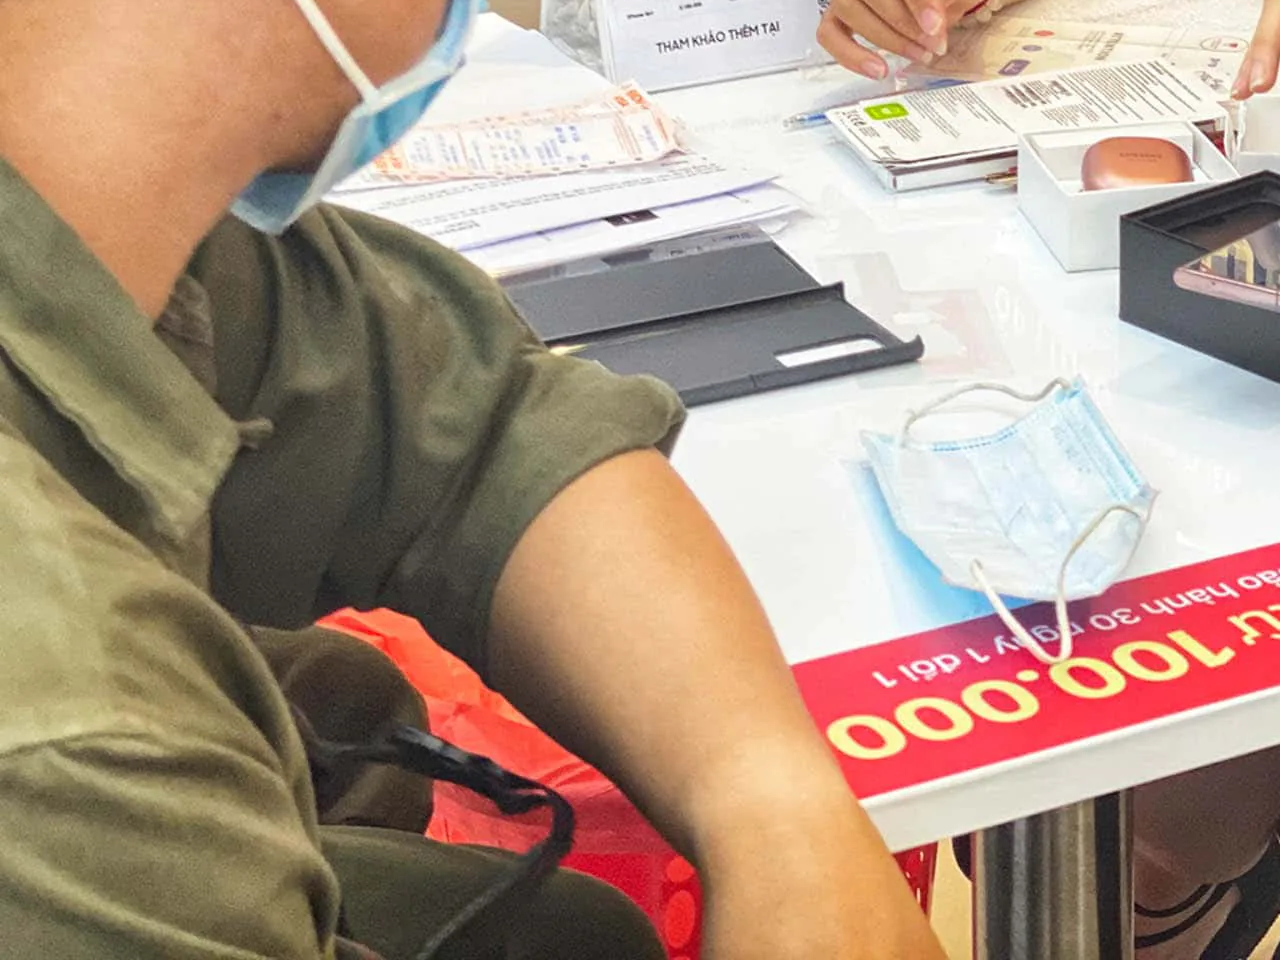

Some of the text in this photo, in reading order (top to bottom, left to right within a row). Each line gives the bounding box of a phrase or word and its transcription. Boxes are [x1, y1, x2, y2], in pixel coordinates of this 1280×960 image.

[656, 38, 690, 54] THAM
[1140, 579, 1241, 617] hành
[1089, 607, 1142, 632] 30
[993, 622, 1086, 656] ngy
[898, 653, 963, 683] đổi
[965, 646, 991, 665] 1
[872, 669, 898, 689] 1
[826, 628, 1236, 760] 100.000
